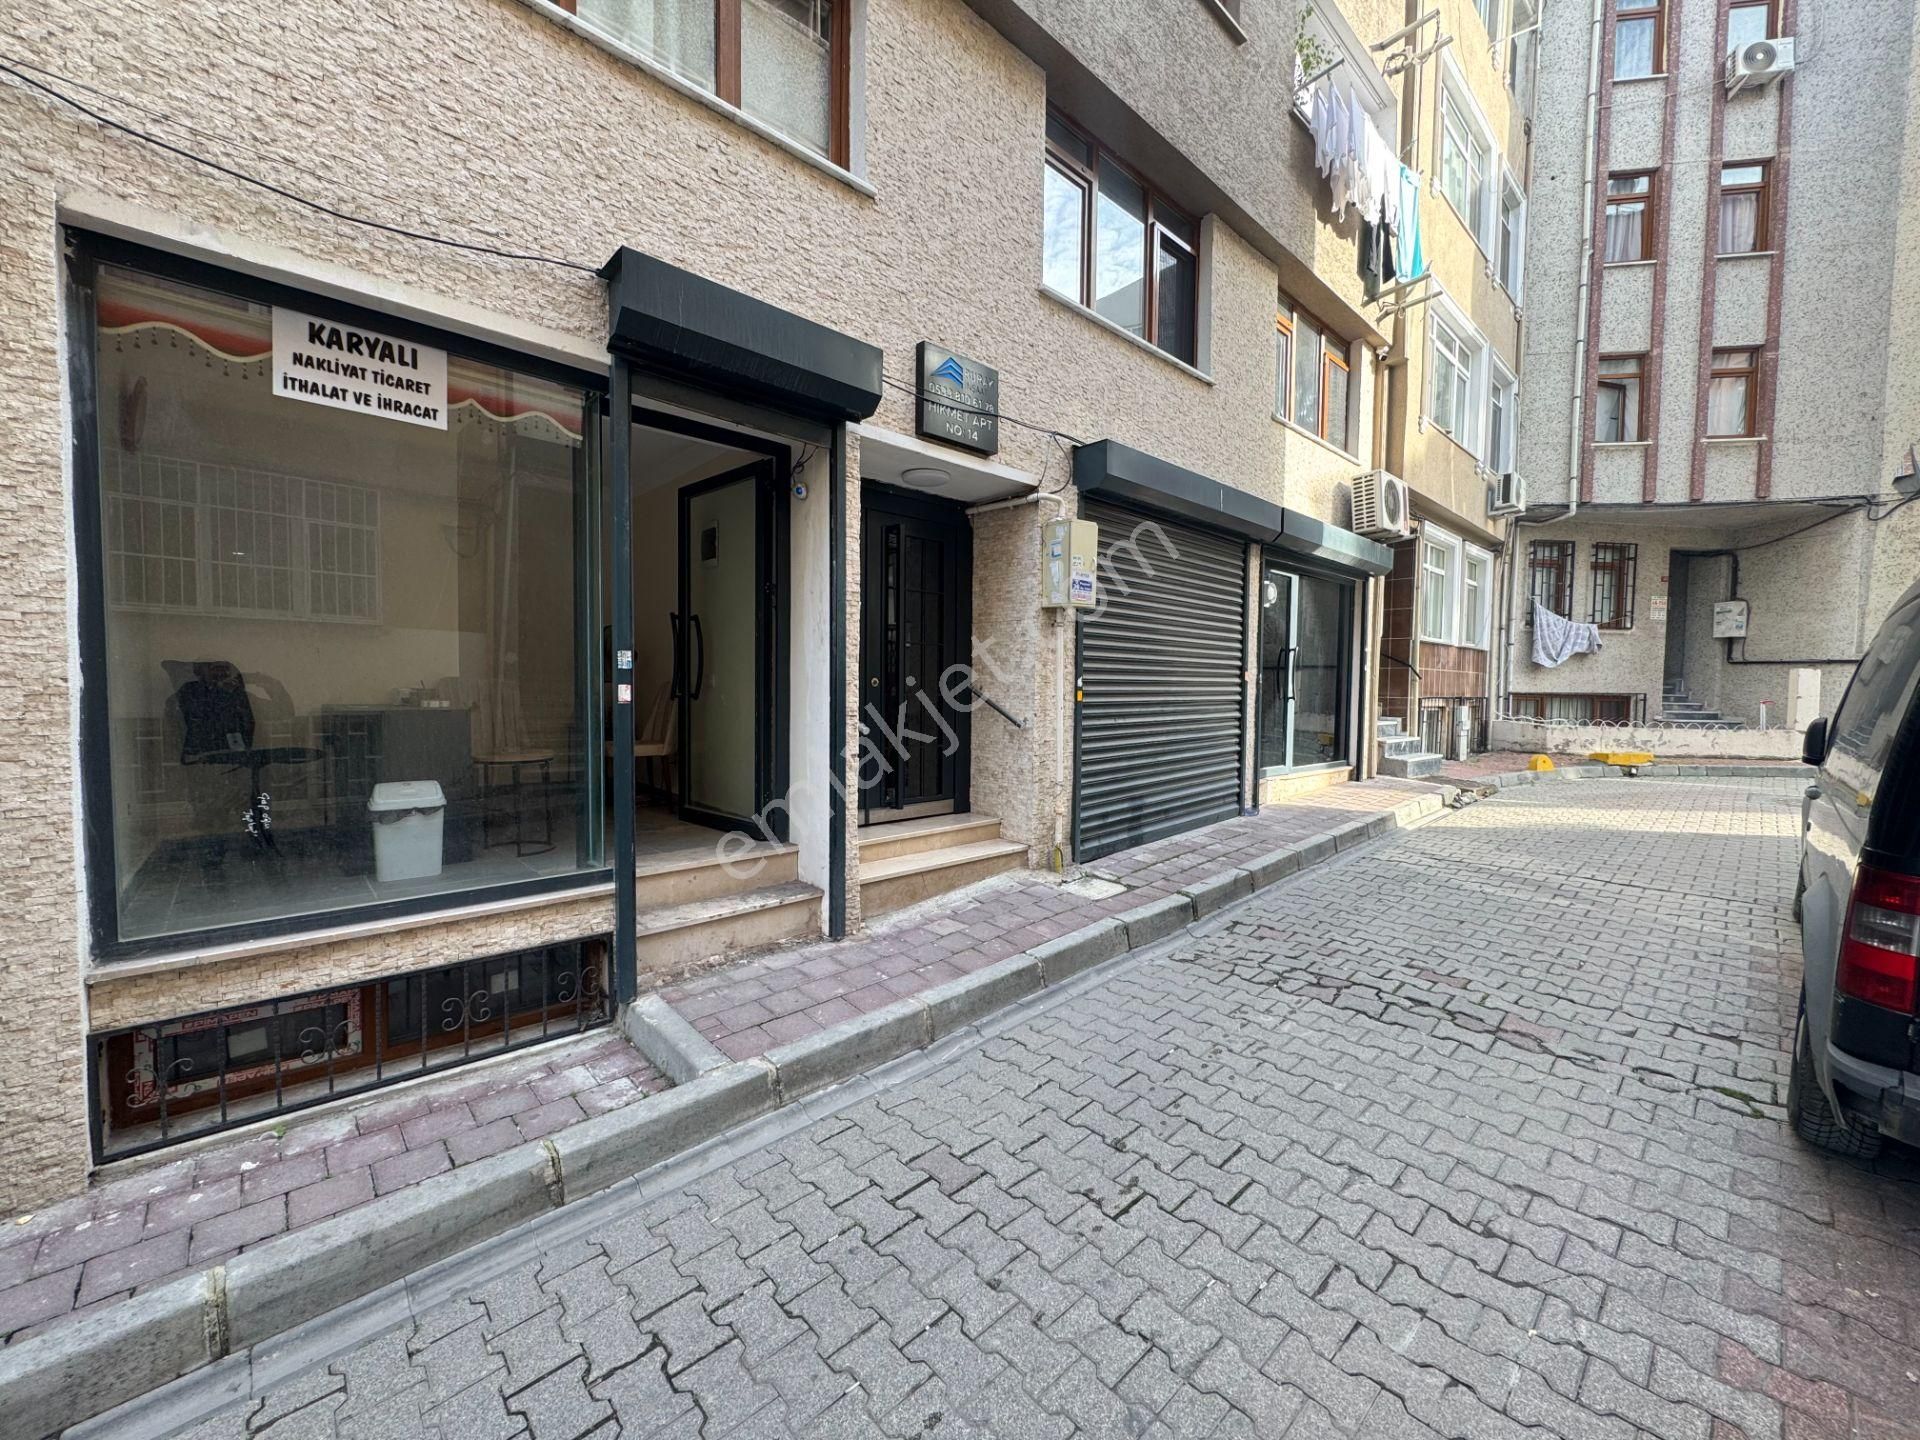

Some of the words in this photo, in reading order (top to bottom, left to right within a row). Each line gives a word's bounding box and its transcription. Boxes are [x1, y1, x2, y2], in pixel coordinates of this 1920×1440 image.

[307, 321, 418, 370] KARYALI
[283, 371, 349, 402] İTHALAT
[352, 391, 372, 406] VE
[377, 393, 439, 421] İHRACAT
[292, 352, 368, 381] NAKLİYAT
[371, 369, 431, 395] TİCARET
[972, 416, 993, 431] APT
